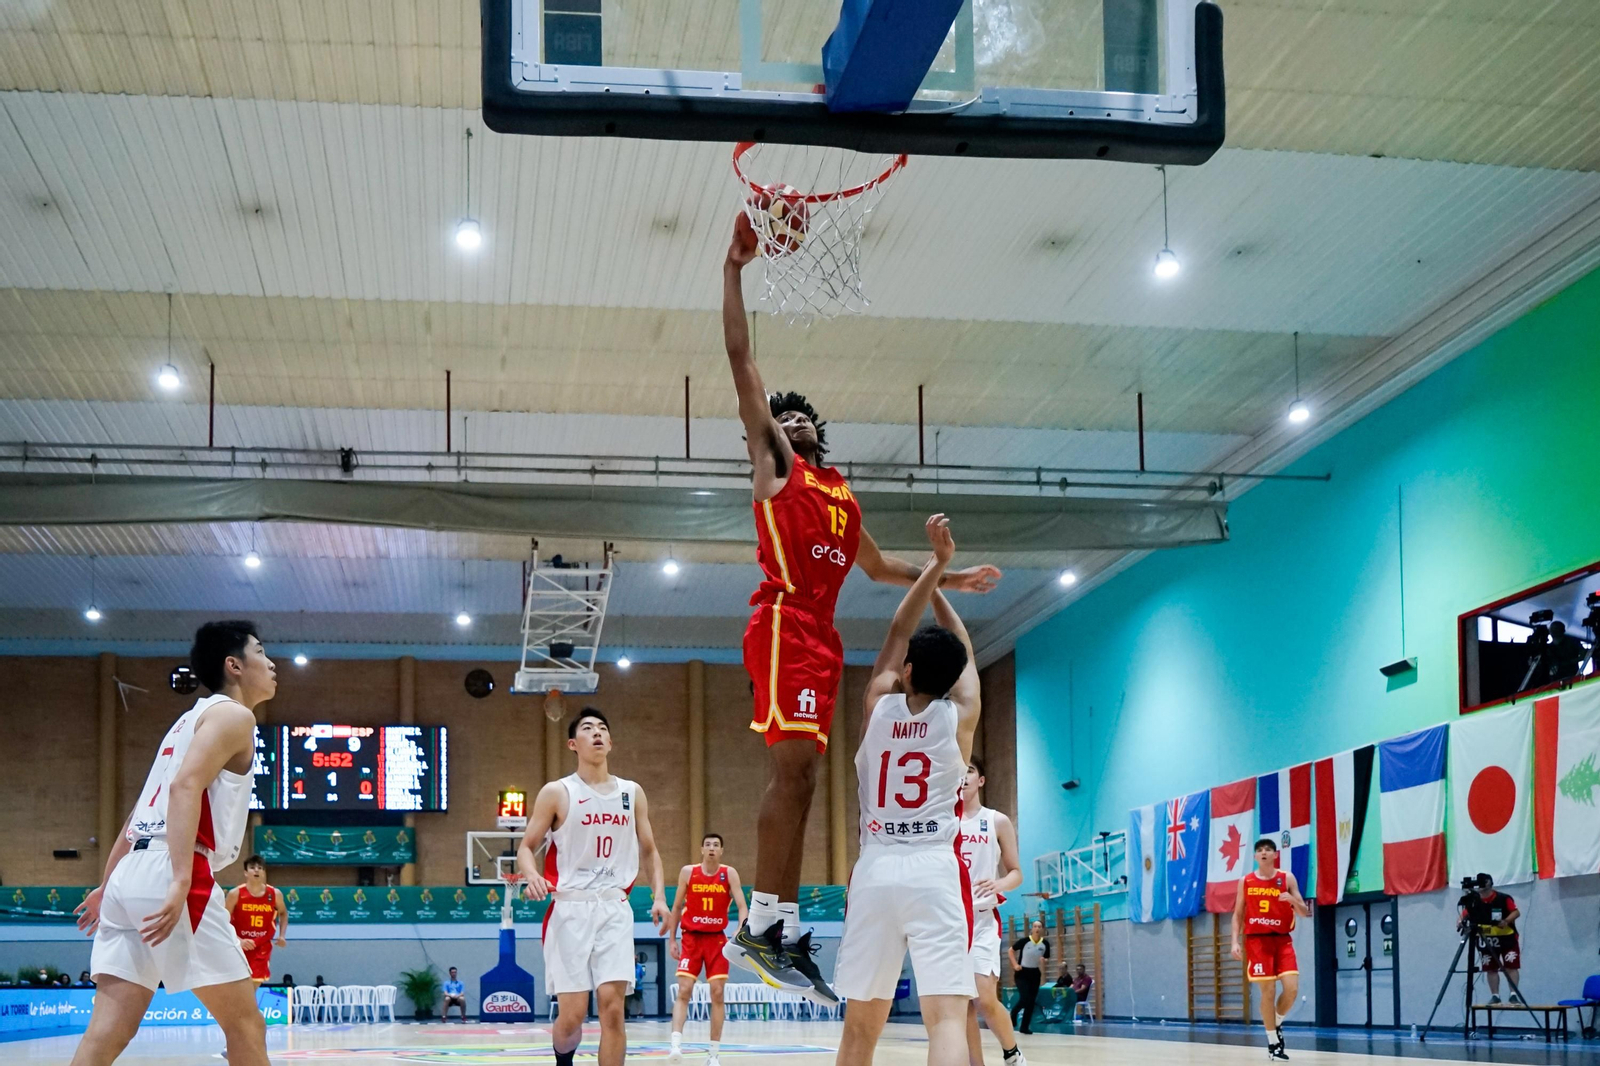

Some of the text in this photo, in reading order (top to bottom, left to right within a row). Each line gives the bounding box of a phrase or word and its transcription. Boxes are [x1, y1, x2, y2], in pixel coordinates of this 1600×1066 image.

[828, 505, 848, 539] 13
[793, 712, 818, 720] network
[291, 726, 314, 737] JPN
[351, 727, 374, 737] ESP
[892, 721, 928, 739] NAITO
[304, 736, 317, 751] 4
[312, 752, 353, 768] 5:52
[327, 772, 337, 787] 1
[877, 750, 932, 809] 13
[294, 780, 304, 794] 1
[360, 781, 372, 795] 0
[501, 801, 523, 817] 24
[581, 813, 630, 826] JAPAN
[884, 820, 939, 835] 日本生命
[961, 834, 988, 844] PAN
[596, 836, 613, 858] 10
[692, 882, 726, 893] ESPAÑA
[1247, 887, 1281, 897] ESPAÑA
[242, 903, 273, 913] ESPAÑA
[702, 898, 714, 911] 11
[1259, 900, 1270, 913] 9
[250, 915, 264, 928] 16
[692, 916, 723, 924] endesa
[1249, 917, 1281, 926] endesa
[1, 1005, 9, 1016] LA
[11, 1004, 29, 1015] TORRE
[143, 1008, 187, 1020] ación
[191, 1008, 202, 1019] &
